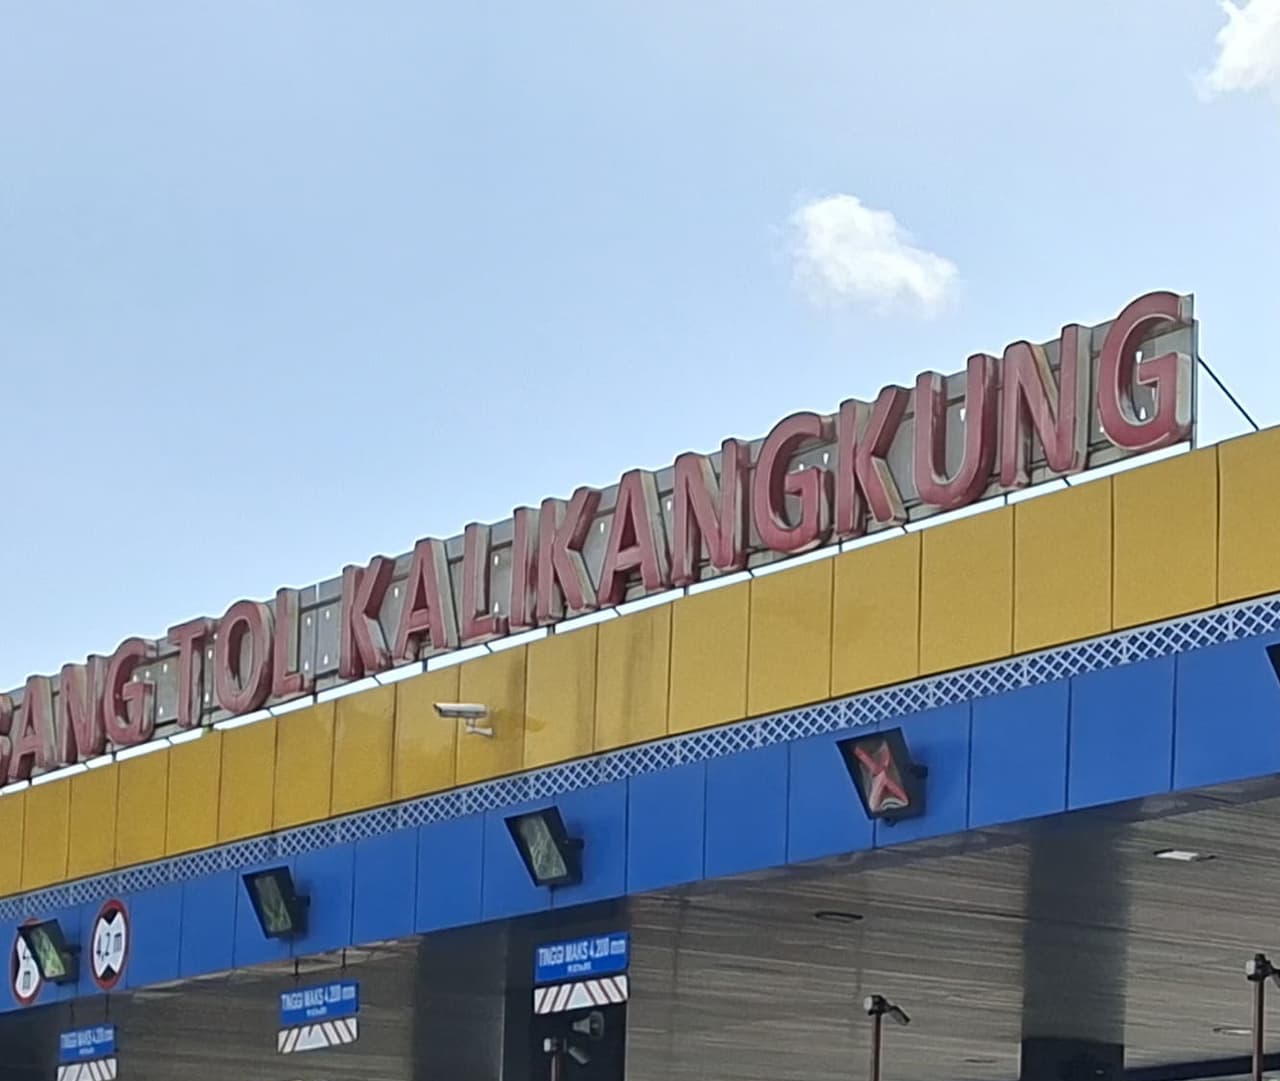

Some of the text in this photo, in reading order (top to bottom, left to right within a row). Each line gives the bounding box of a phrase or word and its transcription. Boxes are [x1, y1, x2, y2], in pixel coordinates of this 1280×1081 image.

[168, 588, 310, 713] TOL
[339, 290, 1193, 679] KALIKANGKUNG
[537, 945, 564, 967] TINGGI
[565, 941, 588, 962] MAKS
